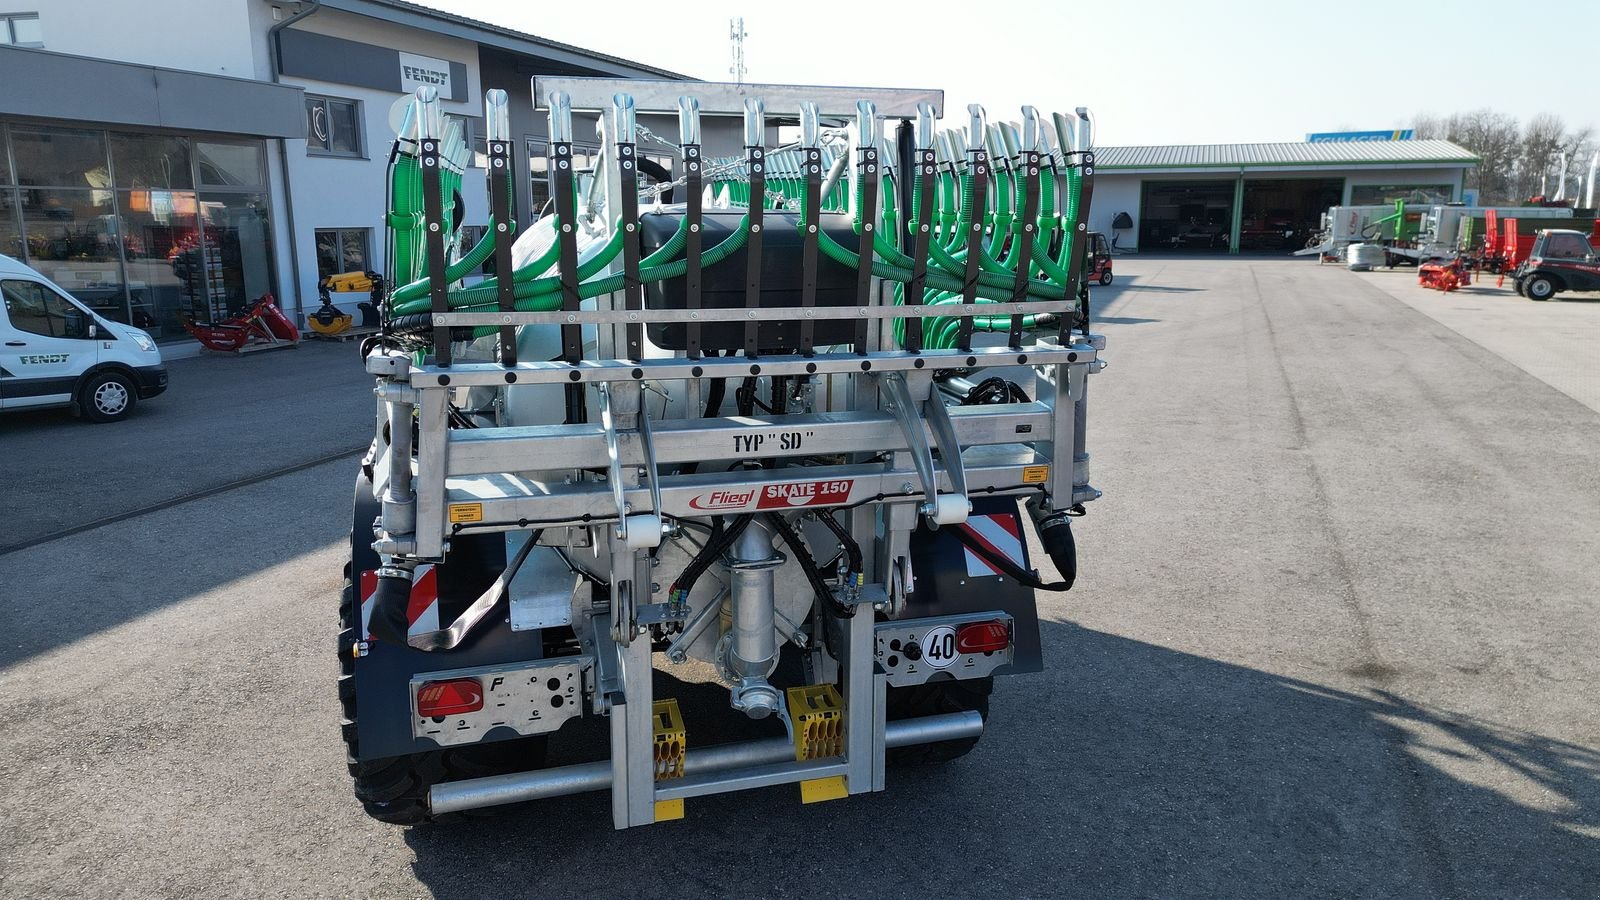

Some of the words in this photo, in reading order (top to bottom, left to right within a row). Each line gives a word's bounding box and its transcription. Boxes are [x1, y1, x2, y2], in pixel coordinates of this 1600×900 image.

[403, 65, 448, 86] FENDT
[19, 353, 70, 365] FENDT
[733, 434, 764, 453] TYP
[709, 489, 755, 506] Fliegl
[767, 482, 816, 499] SKATE
[820, 481, 849, 495] 150
[928, 633, 954, 660] 40
